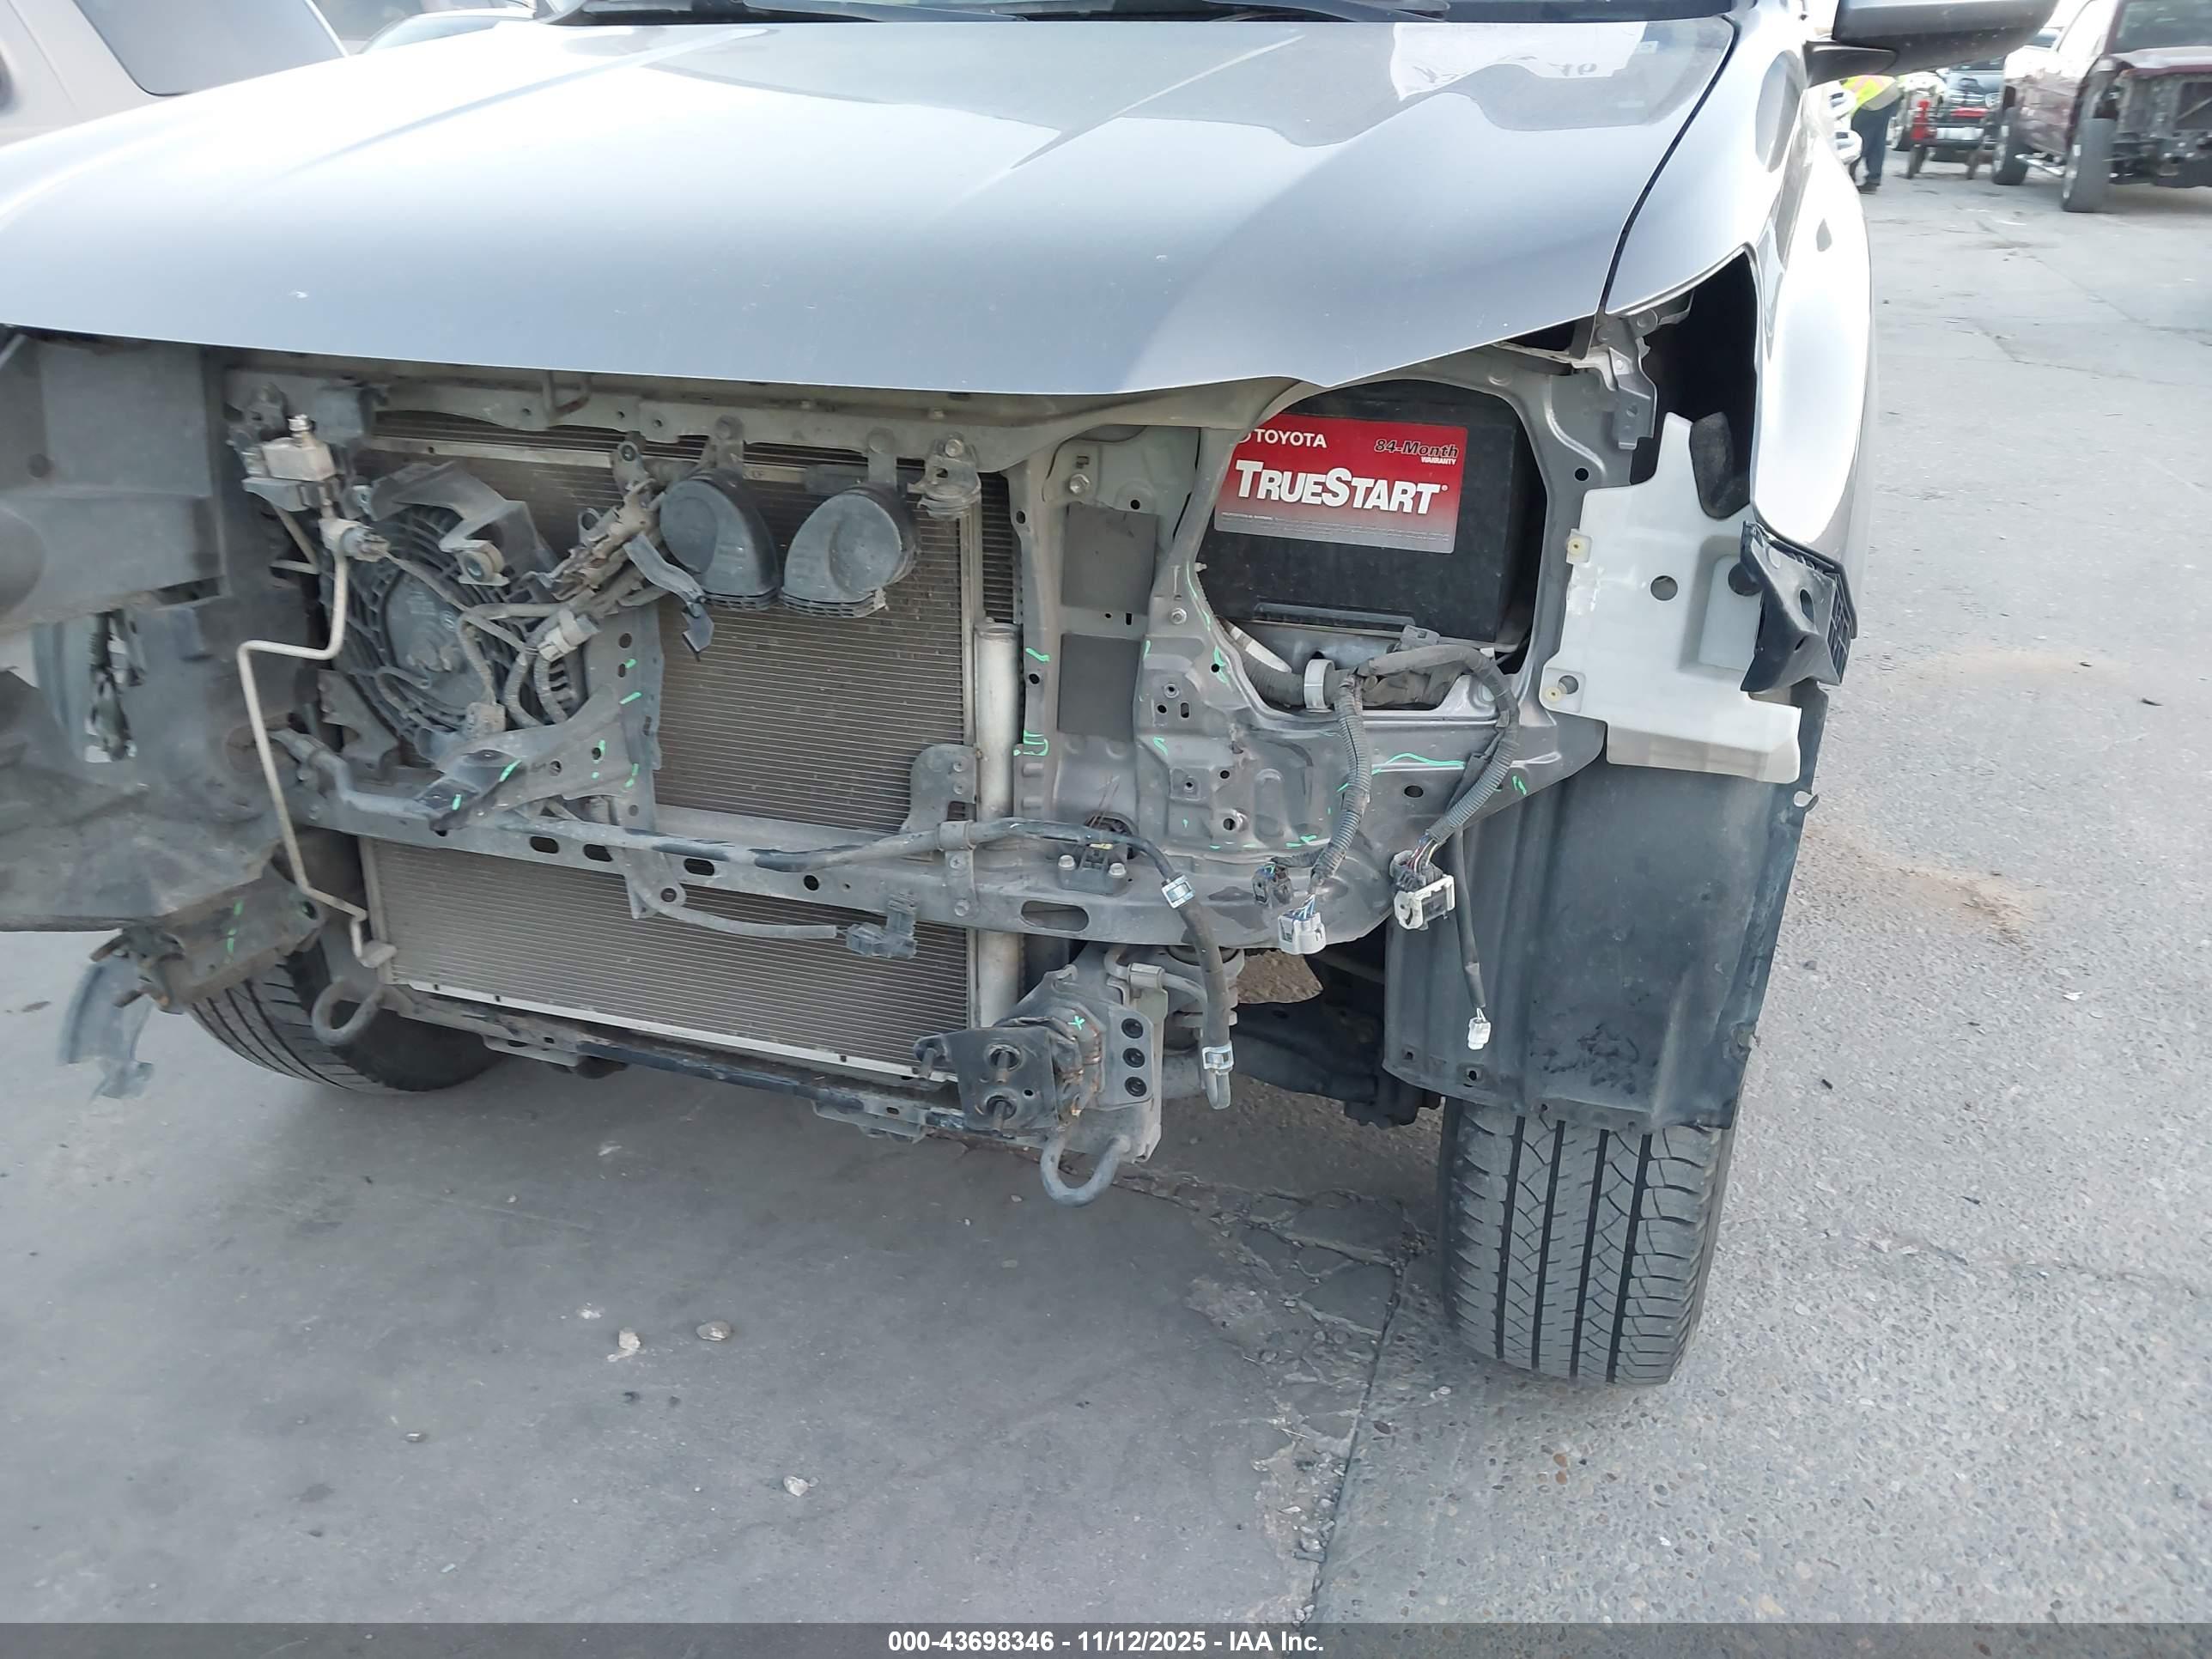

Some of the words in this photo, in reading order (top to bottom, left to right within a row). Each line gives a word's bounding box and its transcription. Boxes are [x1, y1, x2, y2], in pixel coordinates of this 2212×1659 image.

[1254, 428, 1328, 448] TOYOTA
[1374, 439, 1459, 458] 84-Month
[1421, 456, 1457, 465] WARRANTY
